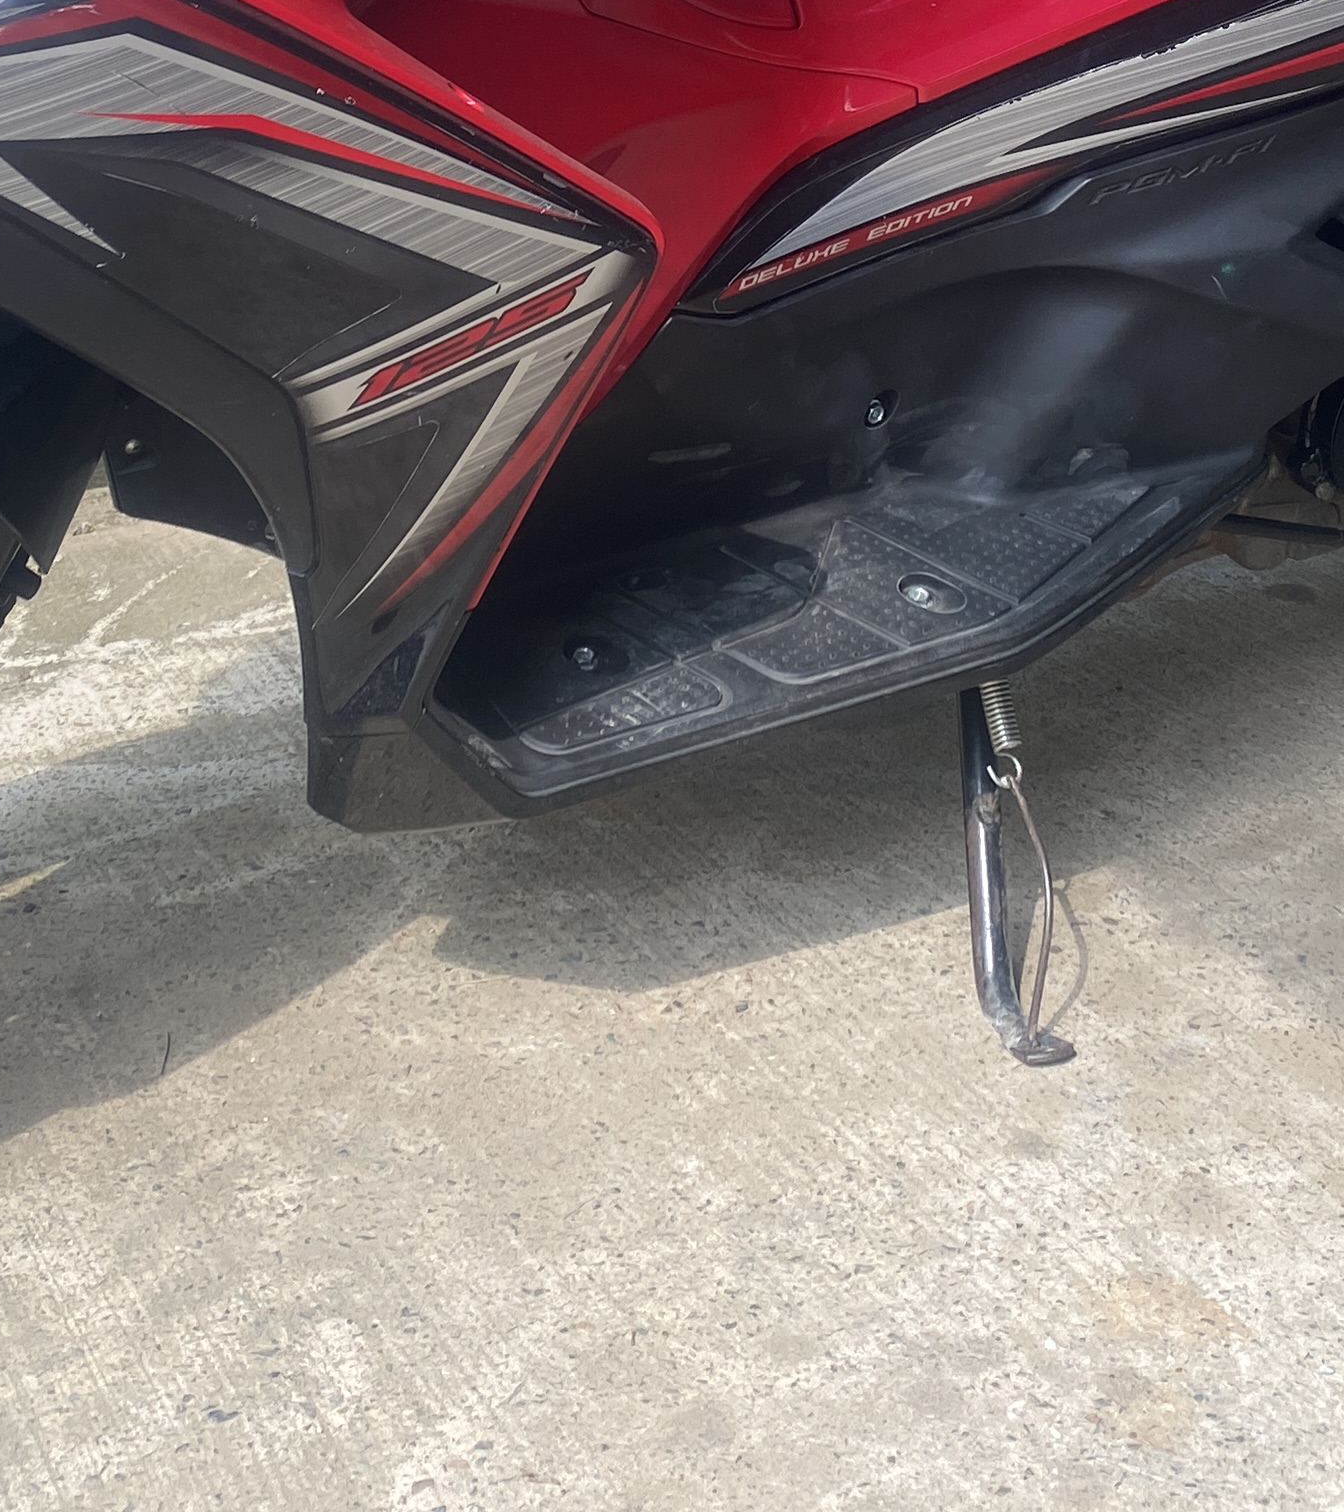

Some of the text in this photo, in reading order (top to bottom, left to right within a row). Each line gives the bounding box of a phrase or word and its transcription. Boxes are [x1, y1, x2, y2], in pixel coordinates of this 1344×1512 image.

[739, 196, 973, 291] DELUXE EDITION
[347, 267, 595, 411] 125
